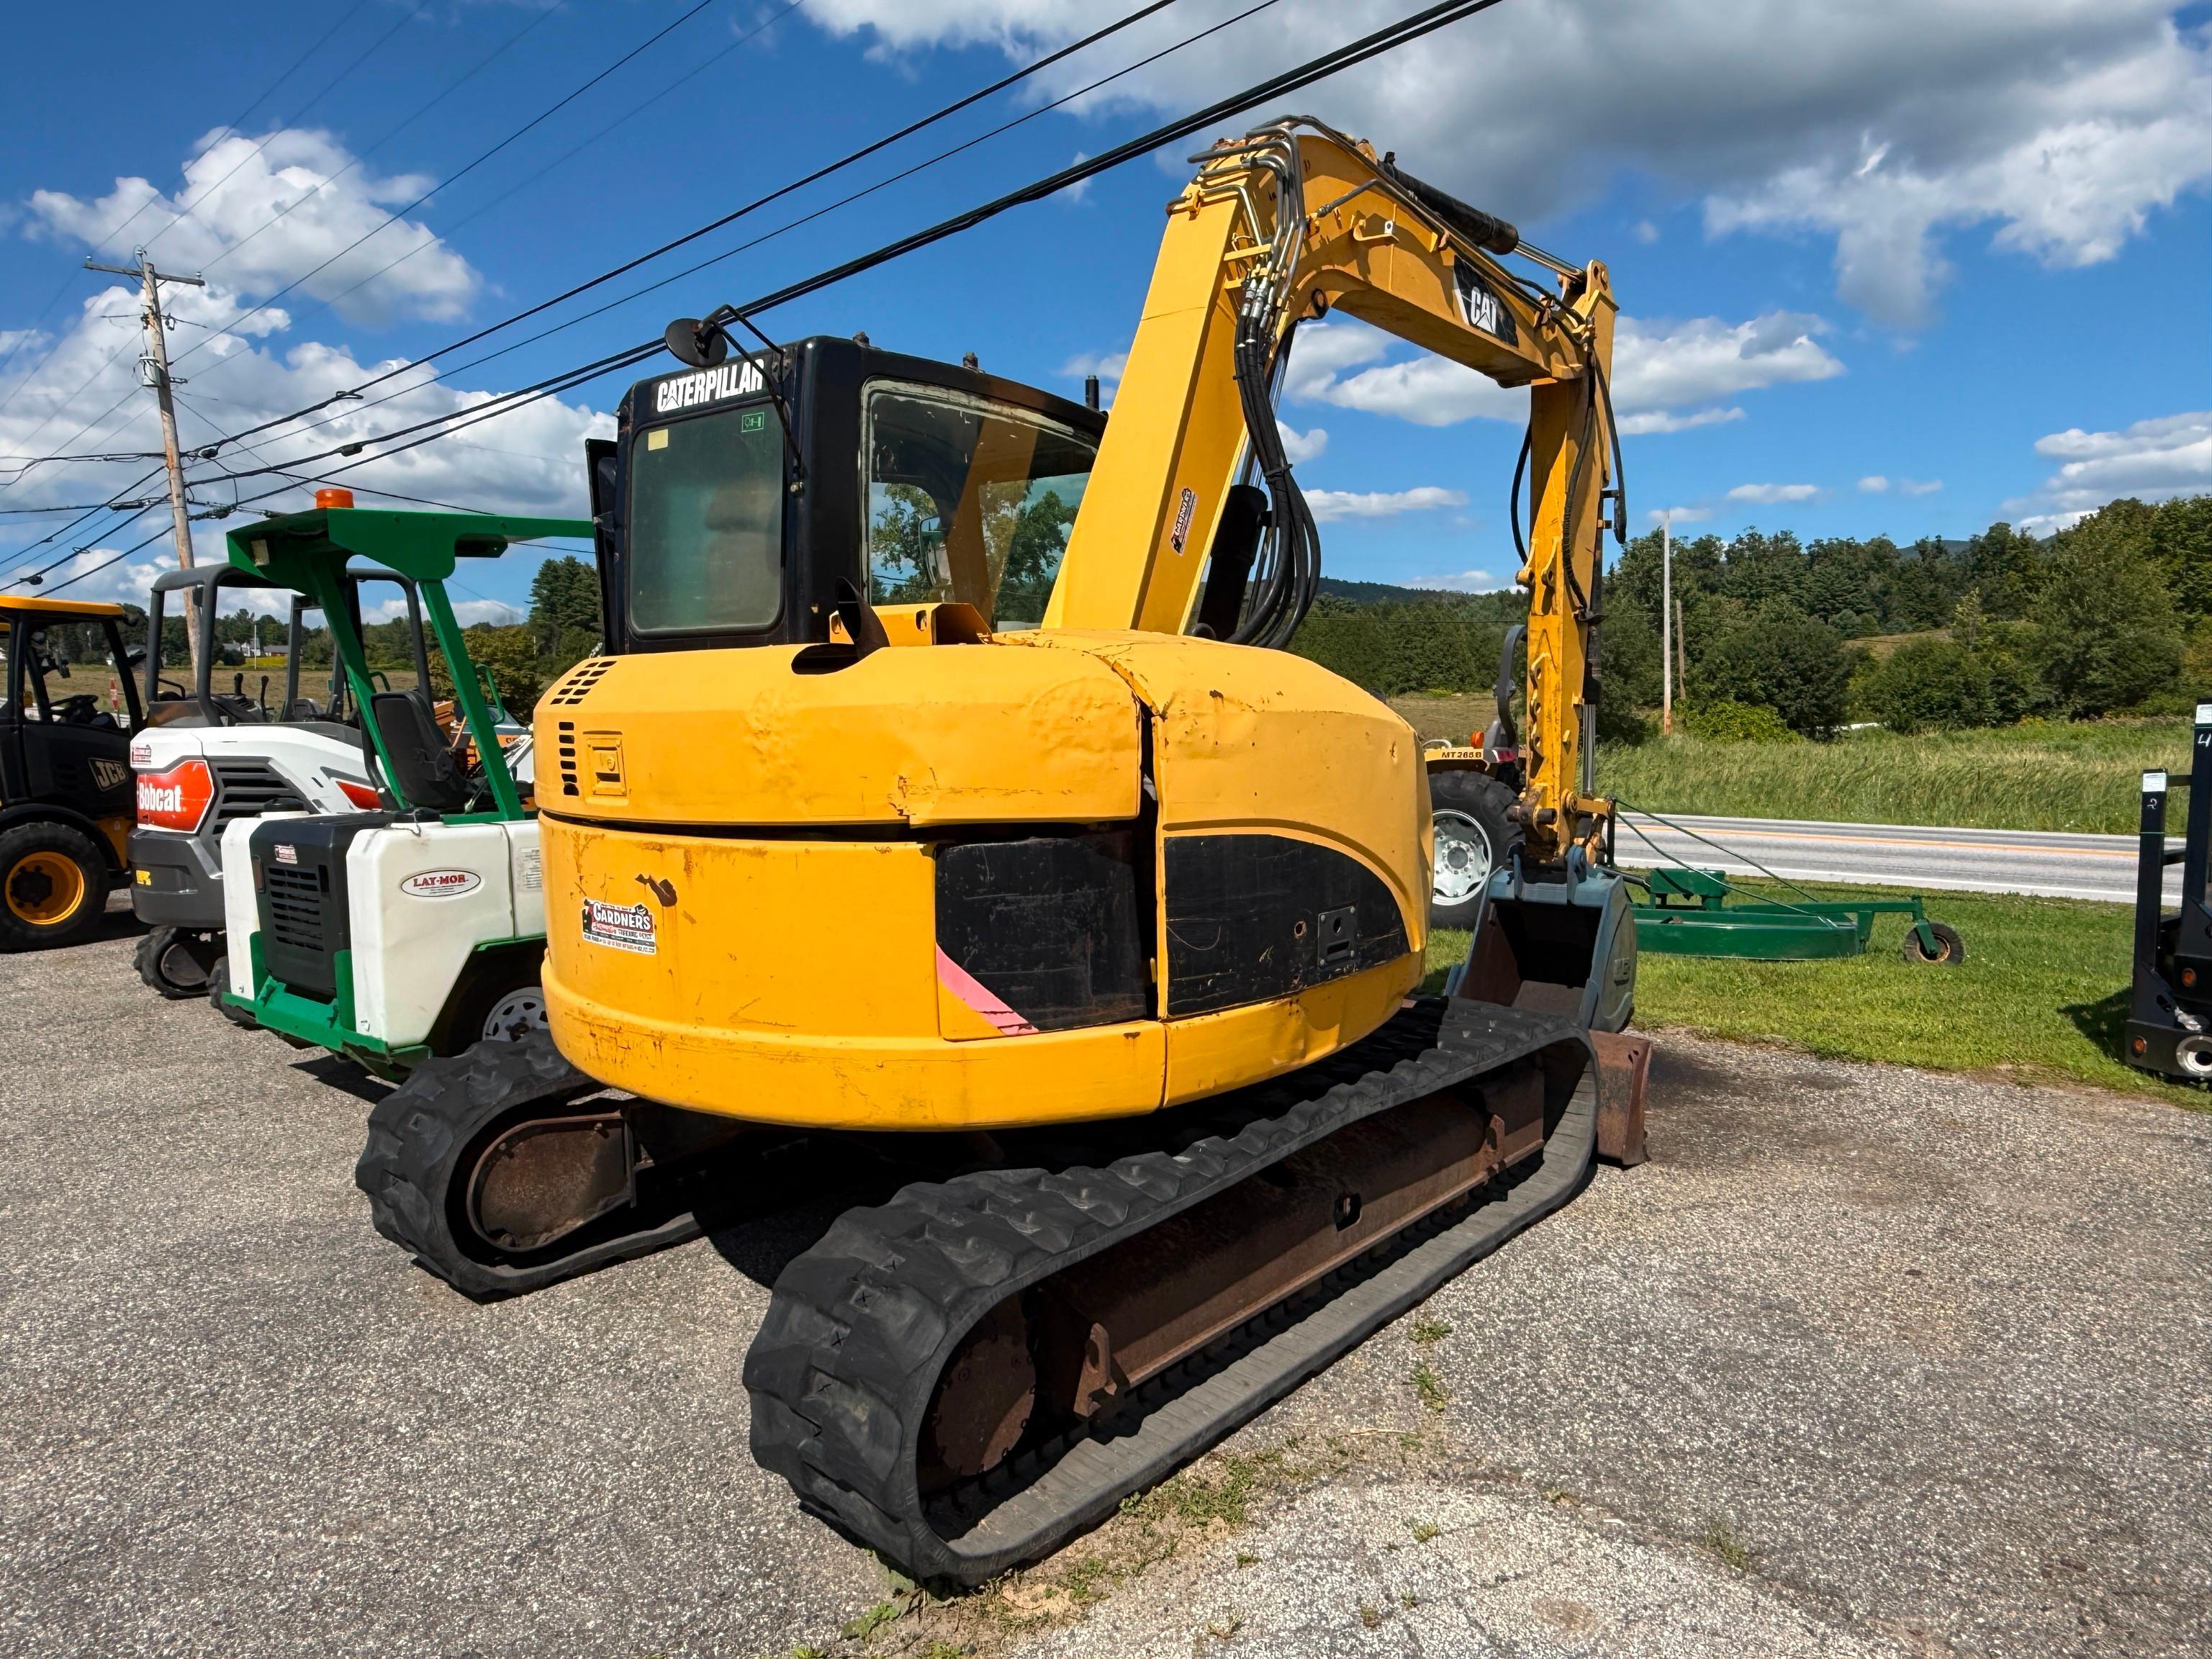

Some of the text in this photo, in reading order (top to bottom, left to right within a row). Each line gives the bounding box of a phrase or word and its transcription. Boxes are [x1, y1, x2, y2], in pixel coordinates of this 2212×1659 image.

[1471, 286, 1497, 335] CAT
[656, 359, 764, 412] CATERPILLAR
[2198, 733, 2212, 747] 4
[95, 761, 126, 787] JCB
[139, 782, 182, 813] Bobcat
[413, 874, 466, 887] LAY-MOR
